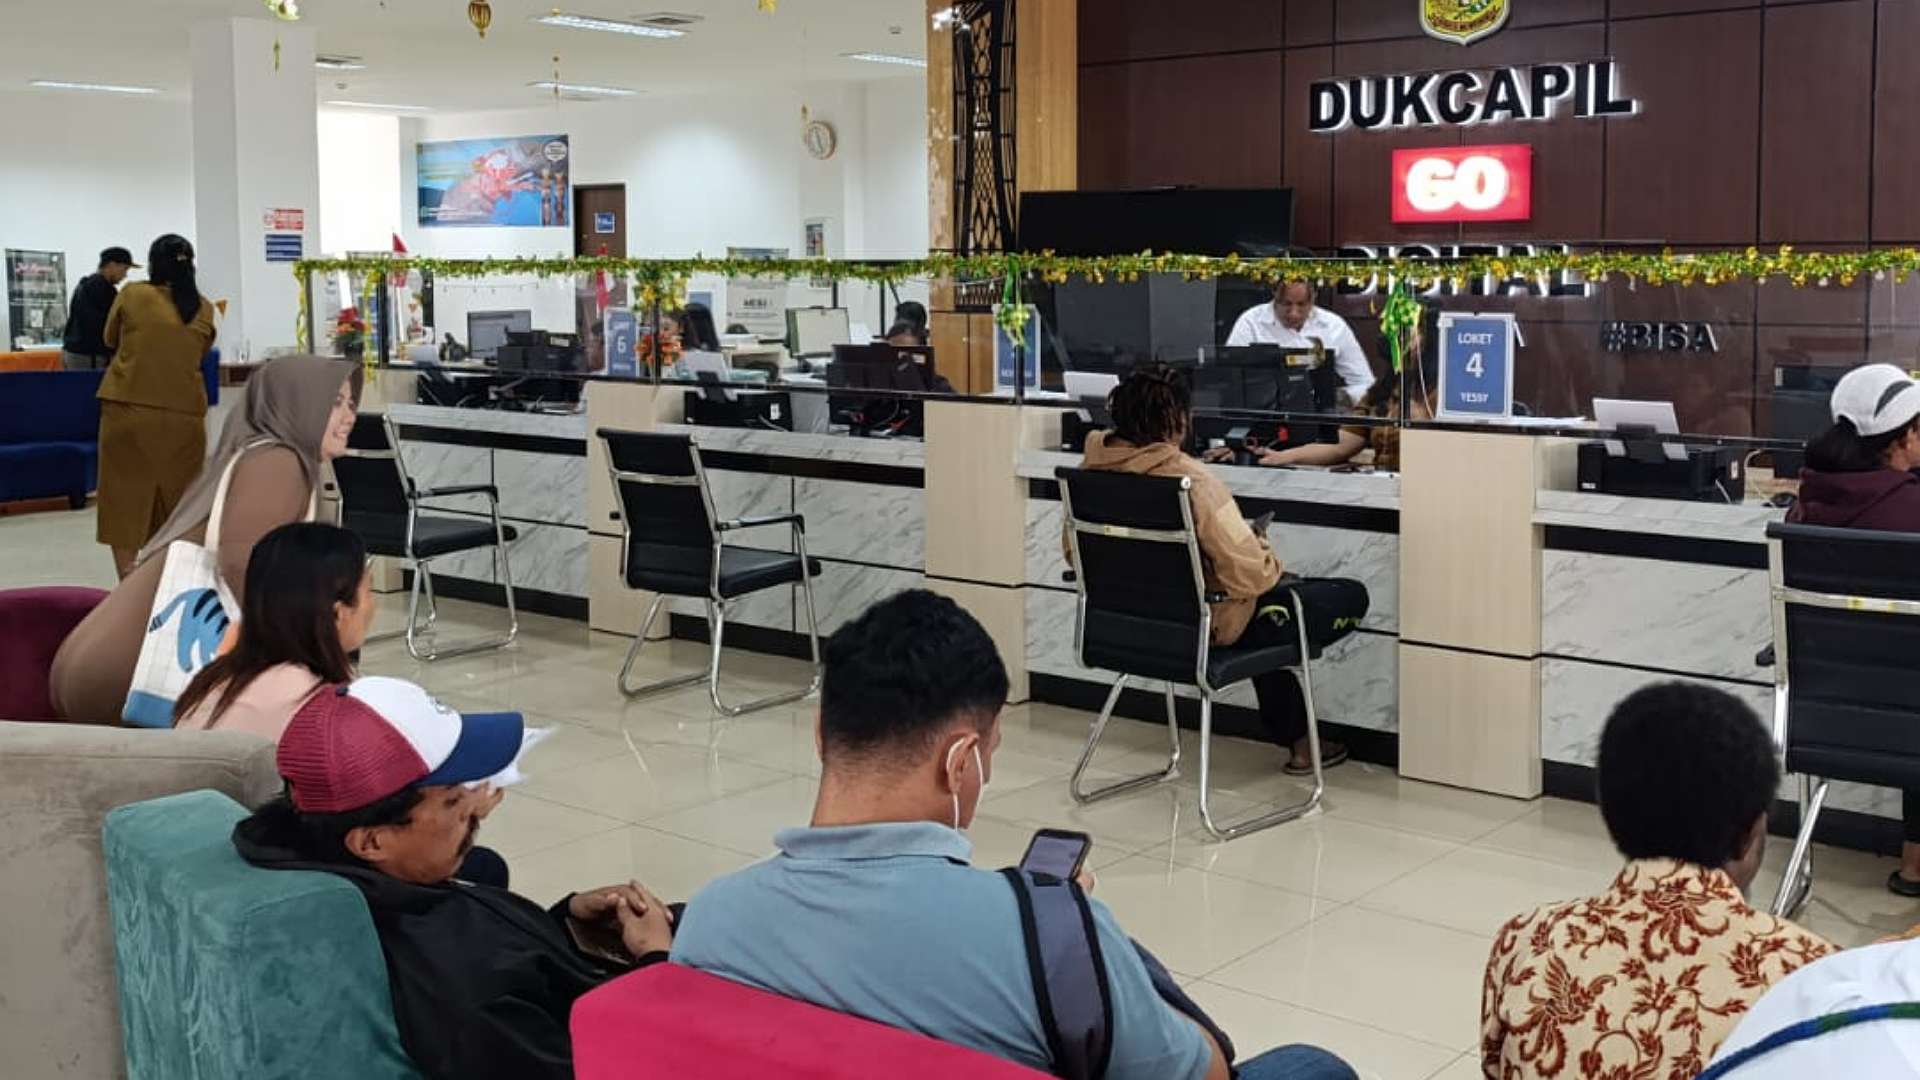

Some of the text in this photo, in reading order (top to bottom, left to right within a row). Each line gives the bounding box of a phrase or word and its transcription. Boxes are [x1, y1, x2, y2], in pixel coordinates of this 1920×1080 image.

[1308, 60, 1637, 132] DUKCAPIL
[617, 335, 627, 353] 6
[1457, 332, 1493, 345] LOKET
[1602, 321, 1718, 352] #BISA
[1465, 352, 1485, 378] 4
